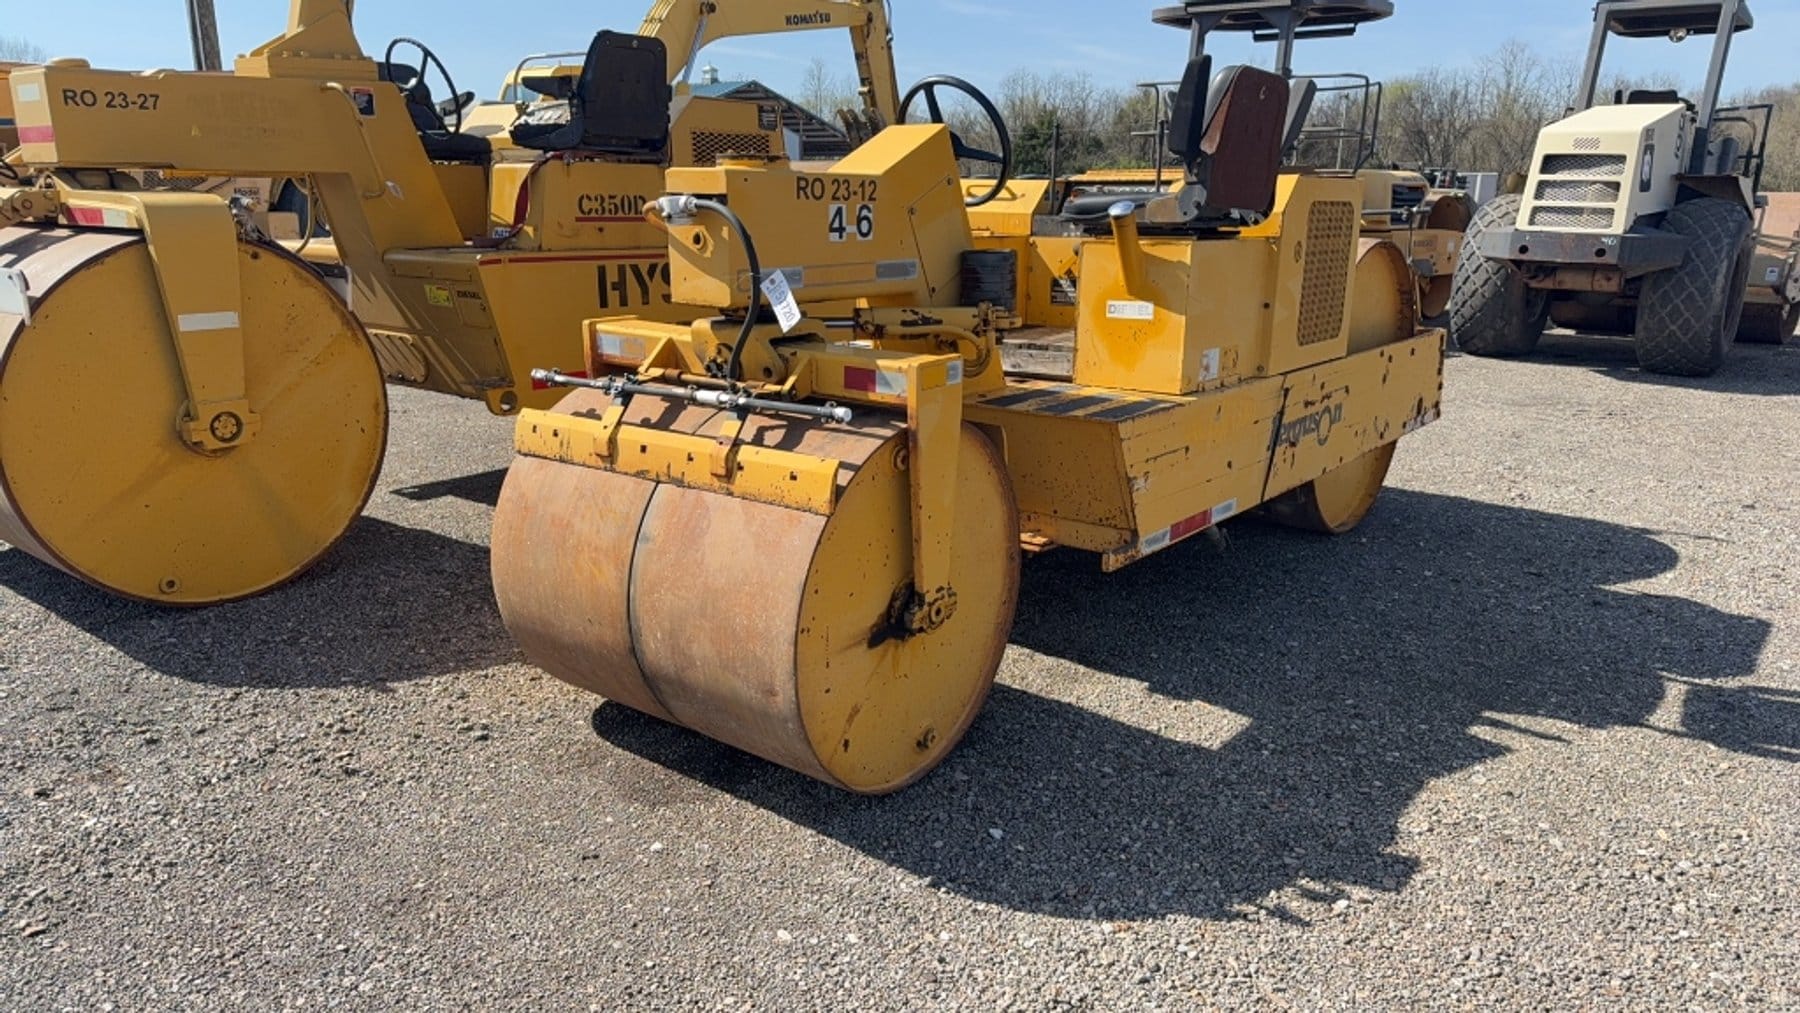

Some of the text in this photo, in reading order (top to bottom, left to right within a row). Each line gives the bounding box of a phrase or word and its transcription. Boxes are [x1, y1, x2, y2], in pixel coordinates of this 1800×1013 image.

[785, 11, 831, 25] KOMATSU
[62, 88, 160, 110] RO 23-27
[796, 176, 877, 201] RO 23-12
